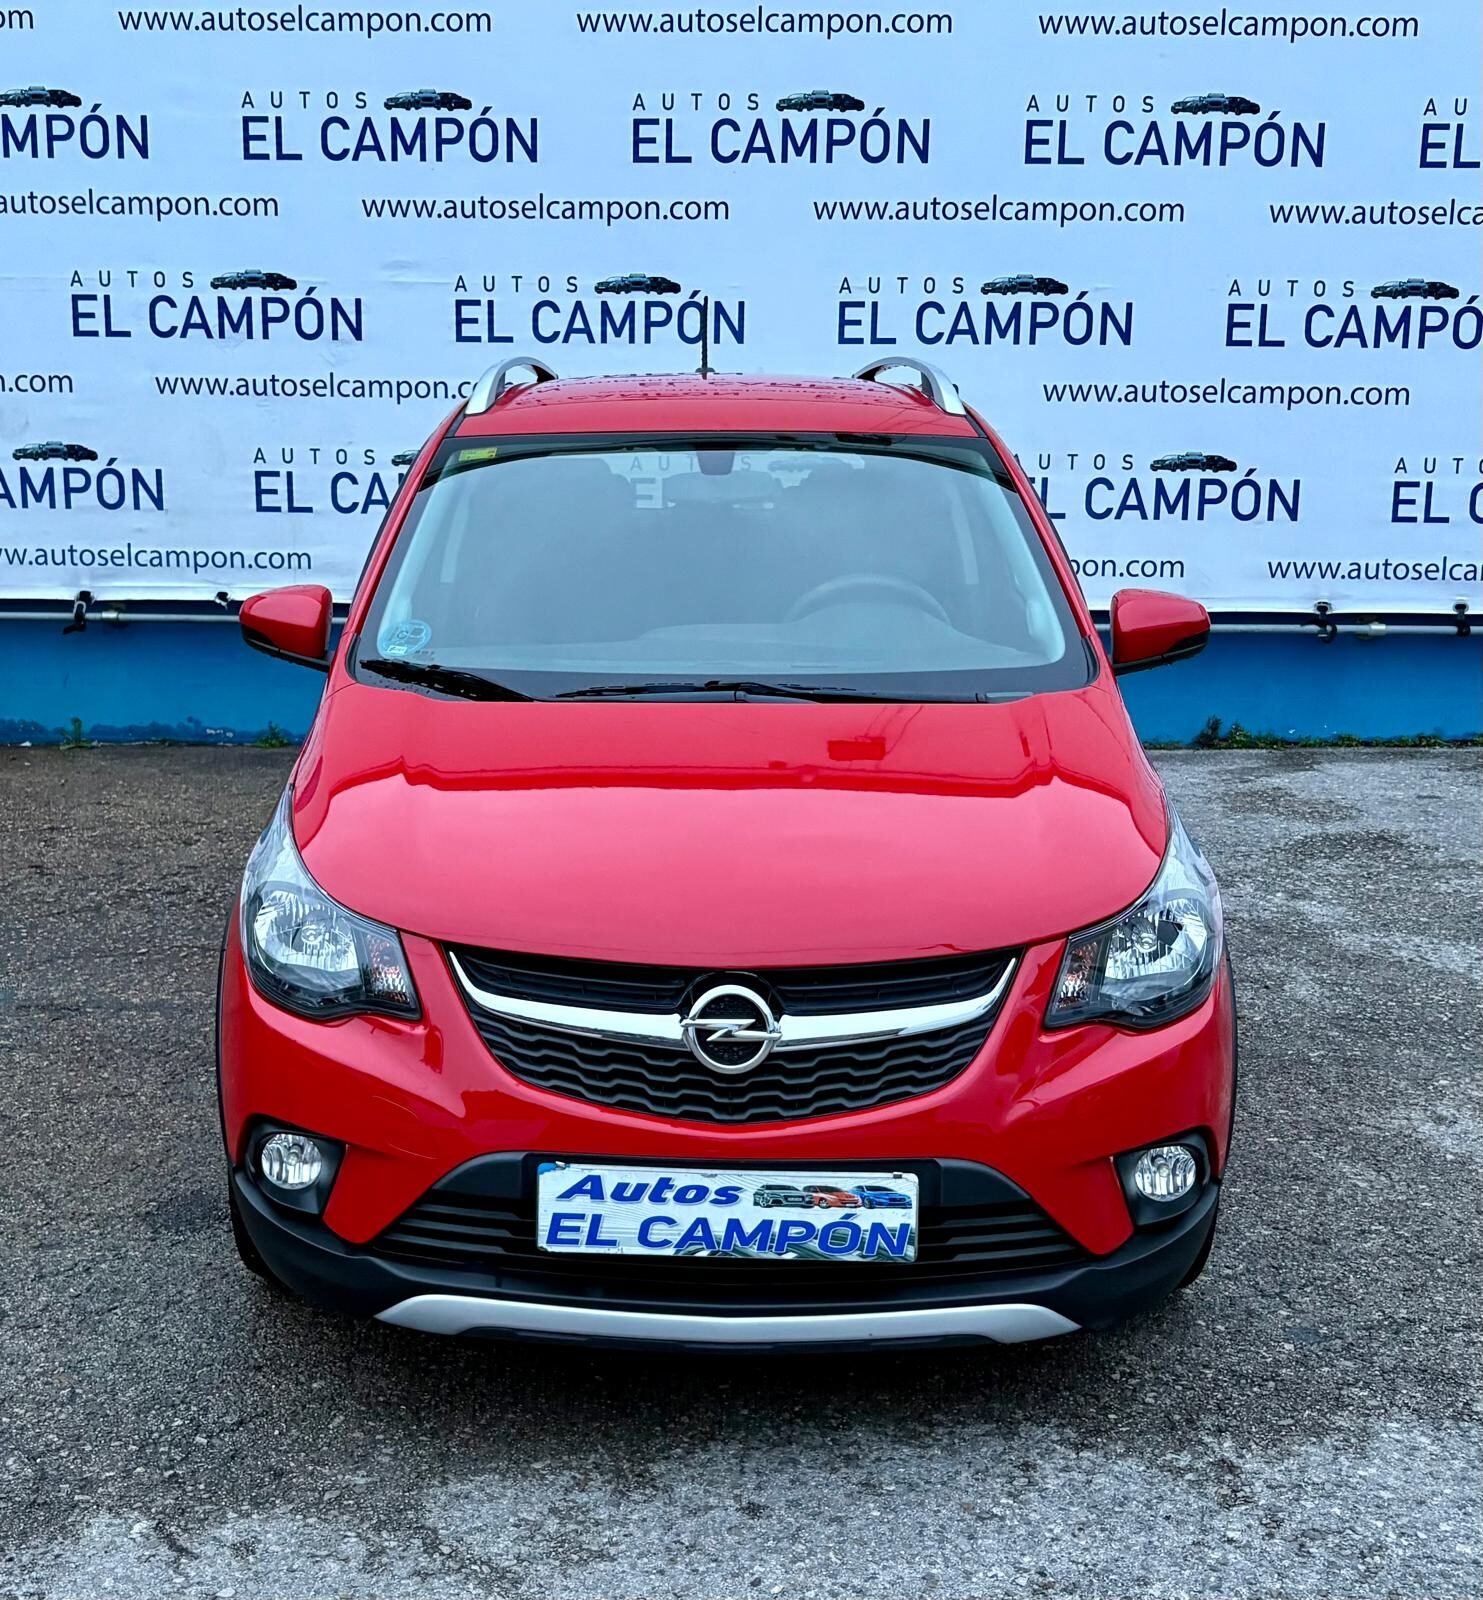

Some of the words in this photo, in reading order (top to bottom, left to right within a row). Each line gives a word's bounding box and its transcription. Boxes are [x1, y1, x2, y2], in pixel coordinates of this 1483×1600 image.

[117, 5, 491, 39] www.autoselcampon.com
[576, 5, 953, 40] www.autoselcampon.com
[1038, 8, 1419, 44] www.autoselcampon.com
[241, 91, 367, 110] AUTOS
[632, 93, 759, 111] AUTOS
[1025, 95, 1154, 114] AUTOS
[0, 103, 149, 160] MPÓN
[241, 116, 303, 161] EL
[320, 107, 538, 163] CAMPÓN
[632, 118, 693, 164] EL
[710, 107, 931, 164] CAMPÓN
[1024, 120, 1085, 165] EL
[1104, 111, 1326, 168] CAMPÓN
[1419, 123, 1481, 169] EL
[361, 193, 729, 227] www.autoselcampon.com
[813, 194, 1185, 228] www.autoselcampon.com
[70, 270, 194, 289] AUTOS
[454, 275, 578, 294] AUTOS
[838, 277, 964, 295] AUTOS
[1227, 279, 1354, 298] AUTOS
[71, 294, 132, 338] EL
[148, 286, 363, 342] CAMPÓN
[454, 299, 514, 344] EL
[530, 289, 746, 345] CAMPÓN
[837, 301, 897, 345] EL
[915, 290, 1134, 346] CAMPÓN
[1225, 304, 1286, 348] EL
[1304, 294, 1483, 350] CAMPÓ
[1042, 378, 1410, 411] www.autoselcampon.com
[253, 448, 376, 466] AUTOS
[254, 471, 314, 514] EL
[331, 471, 405, 514] CA
[1029, 477, 1066, 519] L
[1084, 468, 1301, 522] CAMPÓN
[1390, 481, 1450, 524] EL
[0, 543, 312, 575] w.autoselcampon.com
[1267, 556, 1483, 582] www.autoselca
[556, 1174, 745, 1206] Autos
[546, 1212, 618, 1248] EL
[638, 1213, 911, 1257] CAMPÓN
